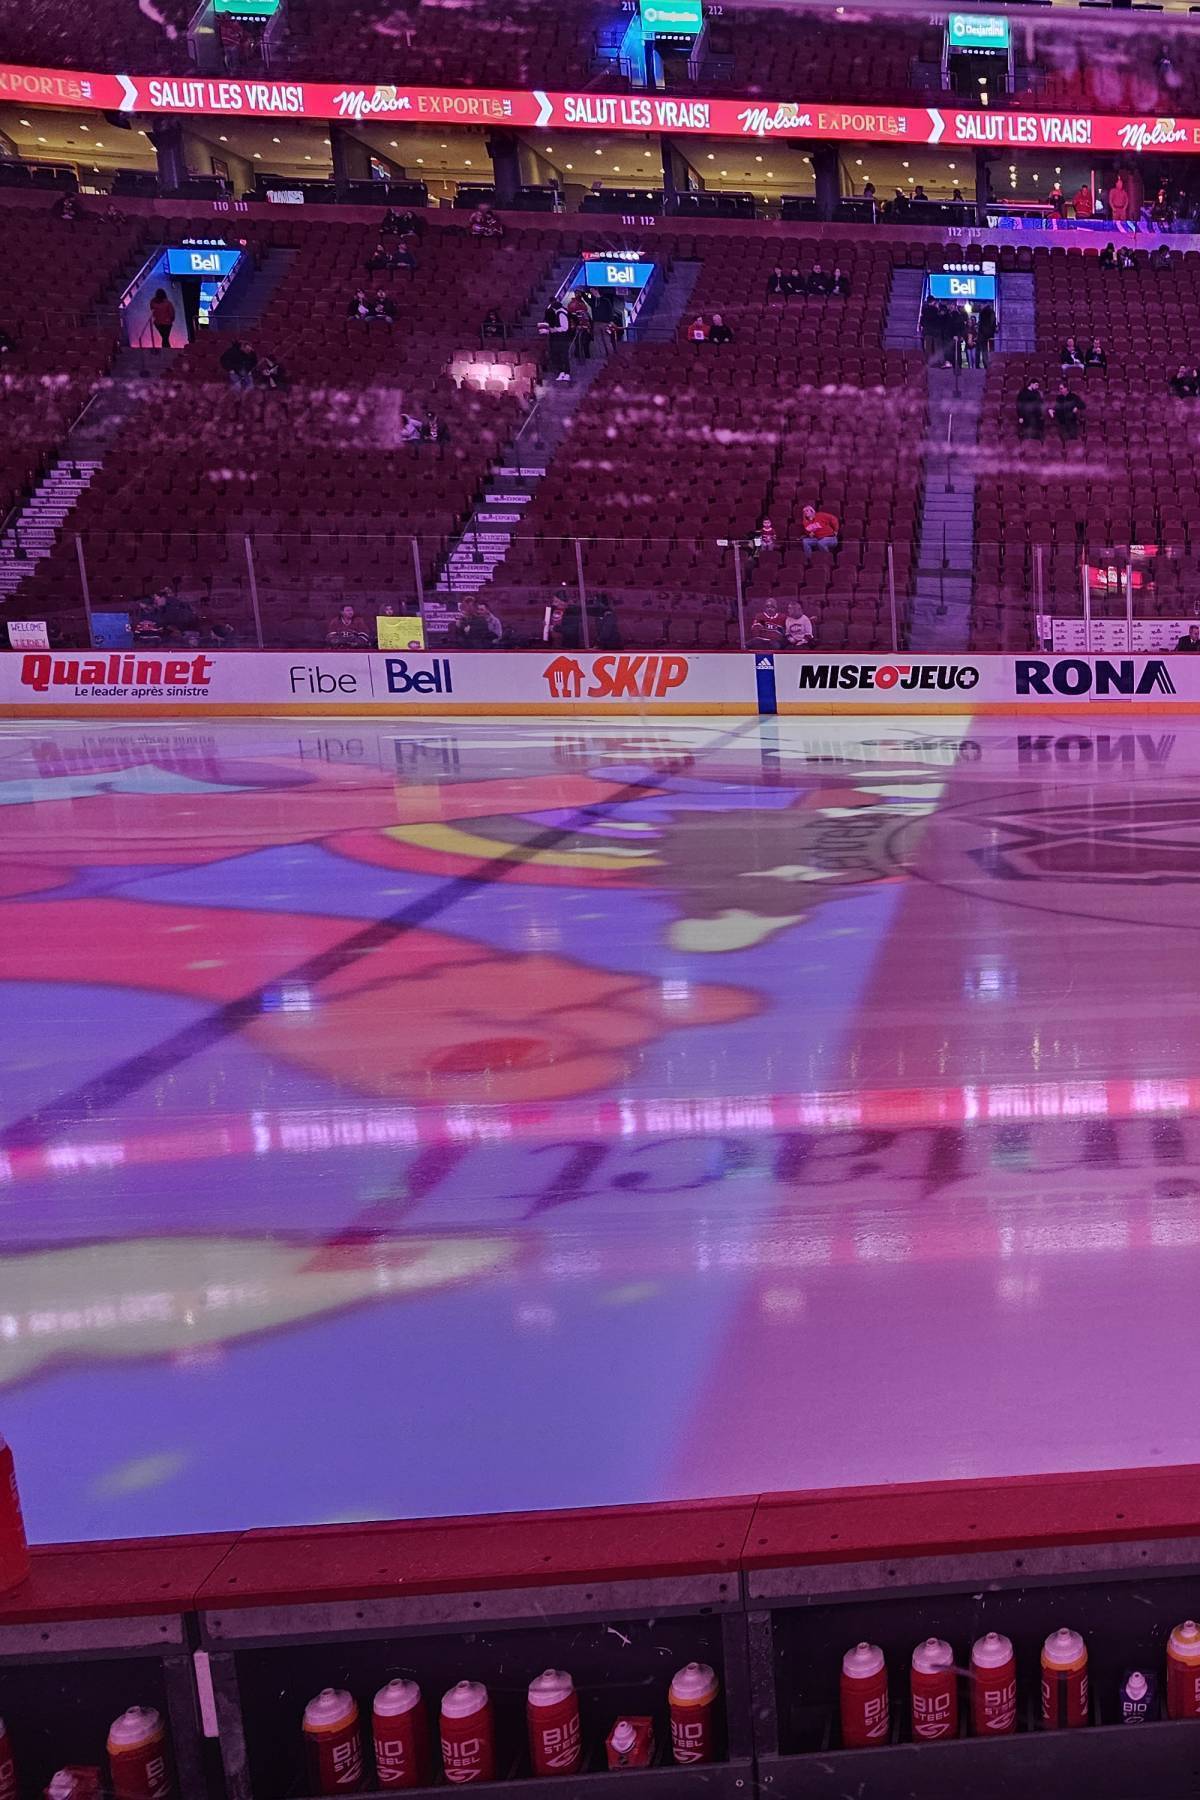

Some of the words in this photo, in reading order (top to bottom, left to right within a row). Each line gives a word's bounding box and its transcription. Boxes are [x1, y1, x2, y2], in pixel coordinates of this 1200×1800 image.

[622, 2, 636, 11] 211
[708, 6, 723, 15] 212
[0, 72, 68, 96] XPORT
[150, 80, 204, 107] SALUT
[208, 84, 242, 108] LES
[244, 85, 304, 112] VRAIS!
[333, 90, 411, 119] Molson
[418, 96, 491, 117] EXPORT
[564, 97, 617, 123] SALUT
[621, 100, 651, 126] LES
[656, 102, 710, 128] VRAIS!
[737, 104, 812, 136] Molson
[818, 113, 885, 132] EXPORT
[955, 114, 1004, 141] SALUT
[1008, 117, 1037, 141] LES
[1041, 118, 1091, 144] VRAIS!
[1117, 120, 1187, 151] Molson
[213, 202, 229, 211] 110
[234, 202, 248, 211] 111
[622, 216, 635, 224] 111
[640, 217, 655, 225] 112
[948, 228, 962, 237] 112
[968, 229, 981, 237] 113
[191, 254, 220, 271] Bell
[607, 266, 634, 283] Bell
[950, 279, 975, 295] Bell
[11, 622, 44, 632] WELCOME
[21, 654, 213, 691] Qualinet
[290, 666, 357, 693] Fibe
[385, 659, 452, 693] Bell
[588, 656, 688, 697] SKIP
[1015, 659, 1176, 695] RONA
[75, 687, 88, 696] Le
[91, 686, 129, 696] leader
[132, 687, 163, 698] après
[166, 687, 209, 697] sinistre
[985, 1679, 1016, 1704] BIO
[913, 1692, 950, 1713] BIO
[1123, 1702, 1147, 1712] BIO
[914, 1710, 950, 1722] STEEL
[543, 1714, 581, 1745] BIO
